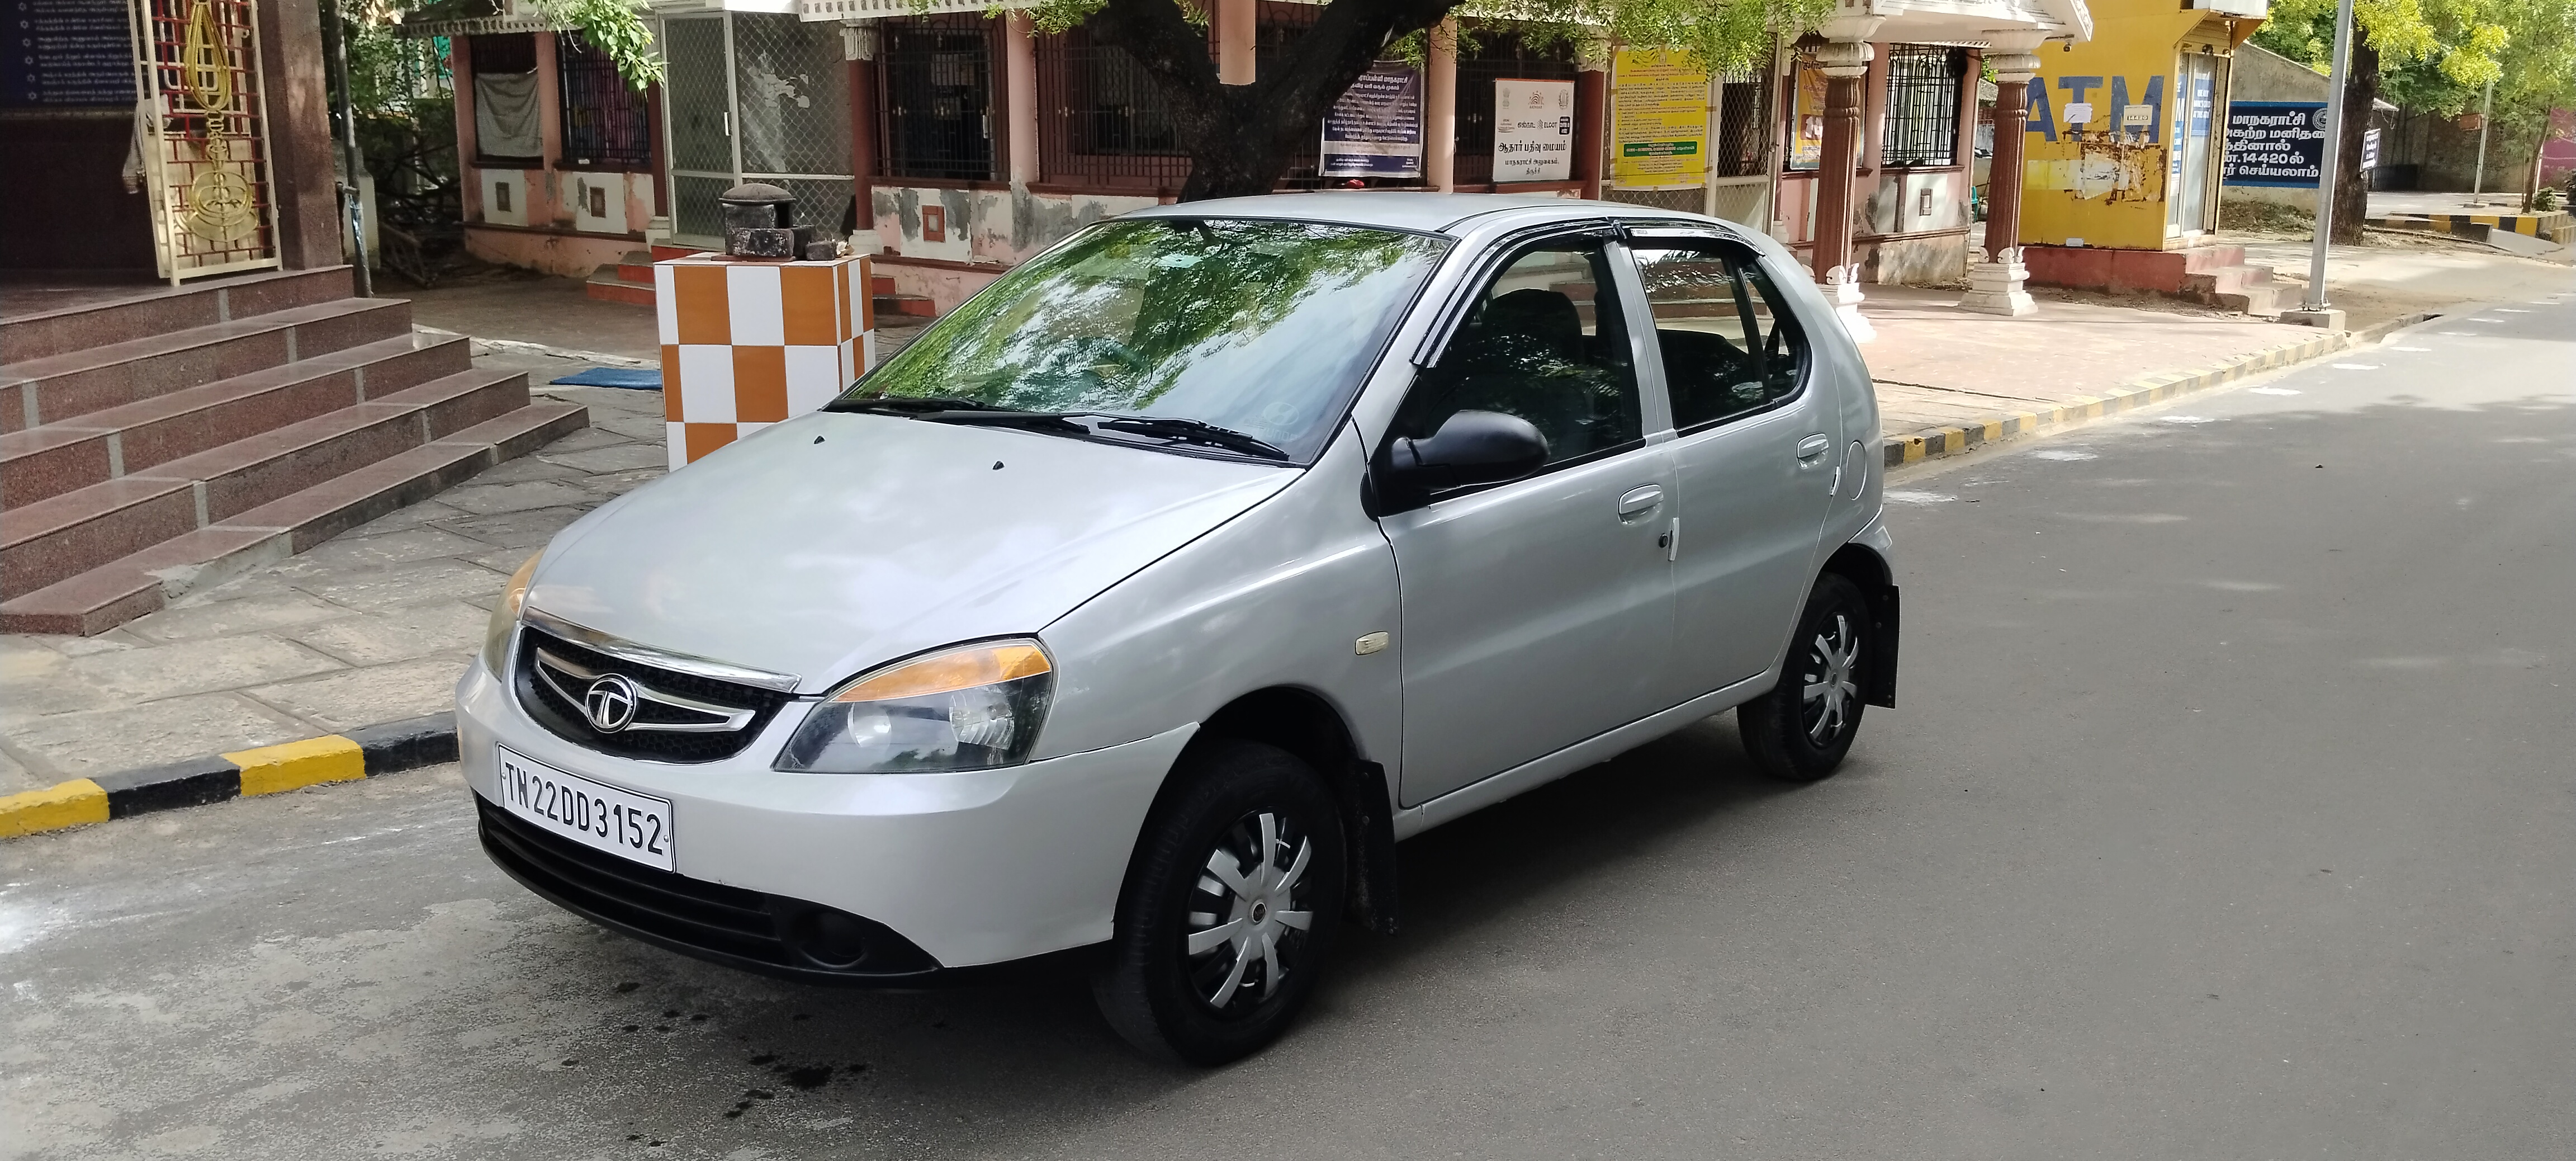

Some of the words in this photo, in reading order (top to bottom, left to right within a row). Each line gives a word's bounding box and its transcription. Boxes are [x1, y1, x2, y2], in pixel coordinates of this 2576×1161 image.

[2025, 75, 2165, 144] ATM
[2232, 111, 2306, 127] மாநகராட்சி
[1498, 140, 1523, 154] ஆதார்
[1524, 140, 1541, 153] பதிவு
[1542, 140, 1567, 152] மையம்
[505, 761, 664, 856] TN22DD3152
